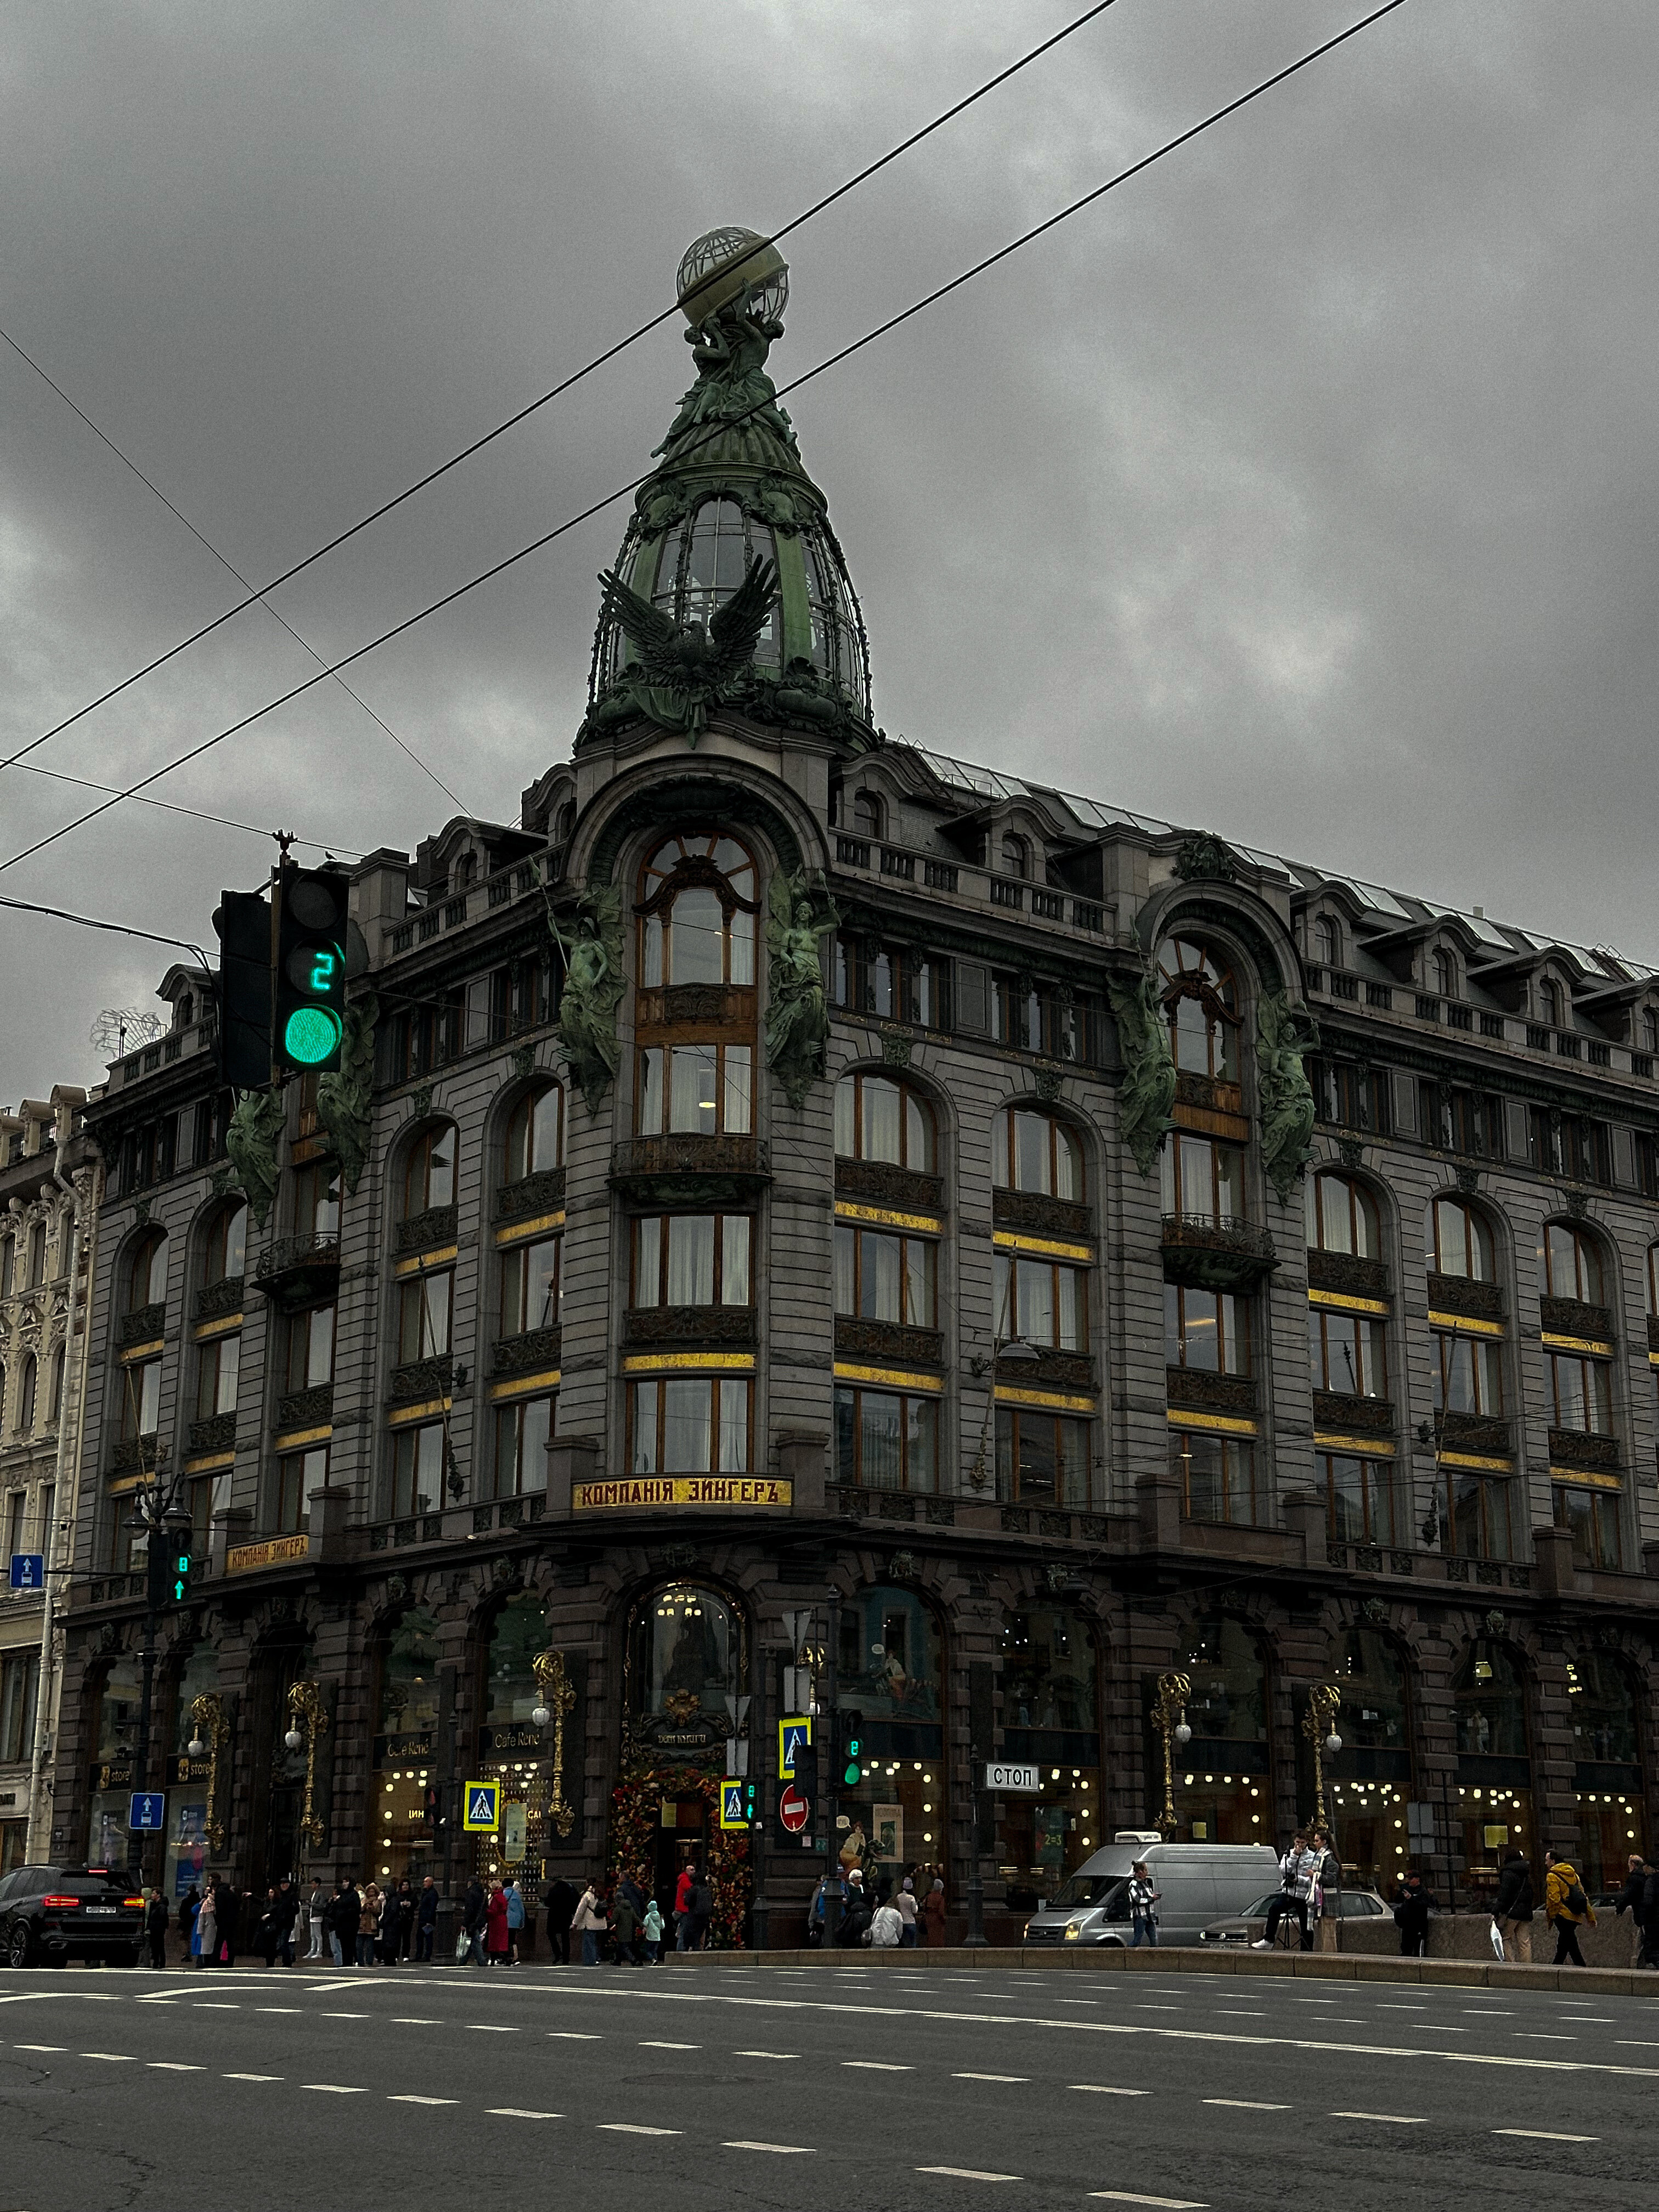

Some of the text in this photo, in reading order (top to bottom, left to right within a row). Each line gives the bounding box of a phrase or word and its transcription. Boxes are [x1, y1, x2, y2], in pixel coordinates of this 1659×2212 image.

[310, 952, 335, 991] 2
[582, 1480, 778, 1505] КОМПАНІЯ ЗИНГЕРЪ
[111, 1769, 130, 1782] store
[190, 1762, 211, 1776] store
[994, 1768, 1031, 1786] СТОП
[1045, 1834, 1062, 1846] 2=3
